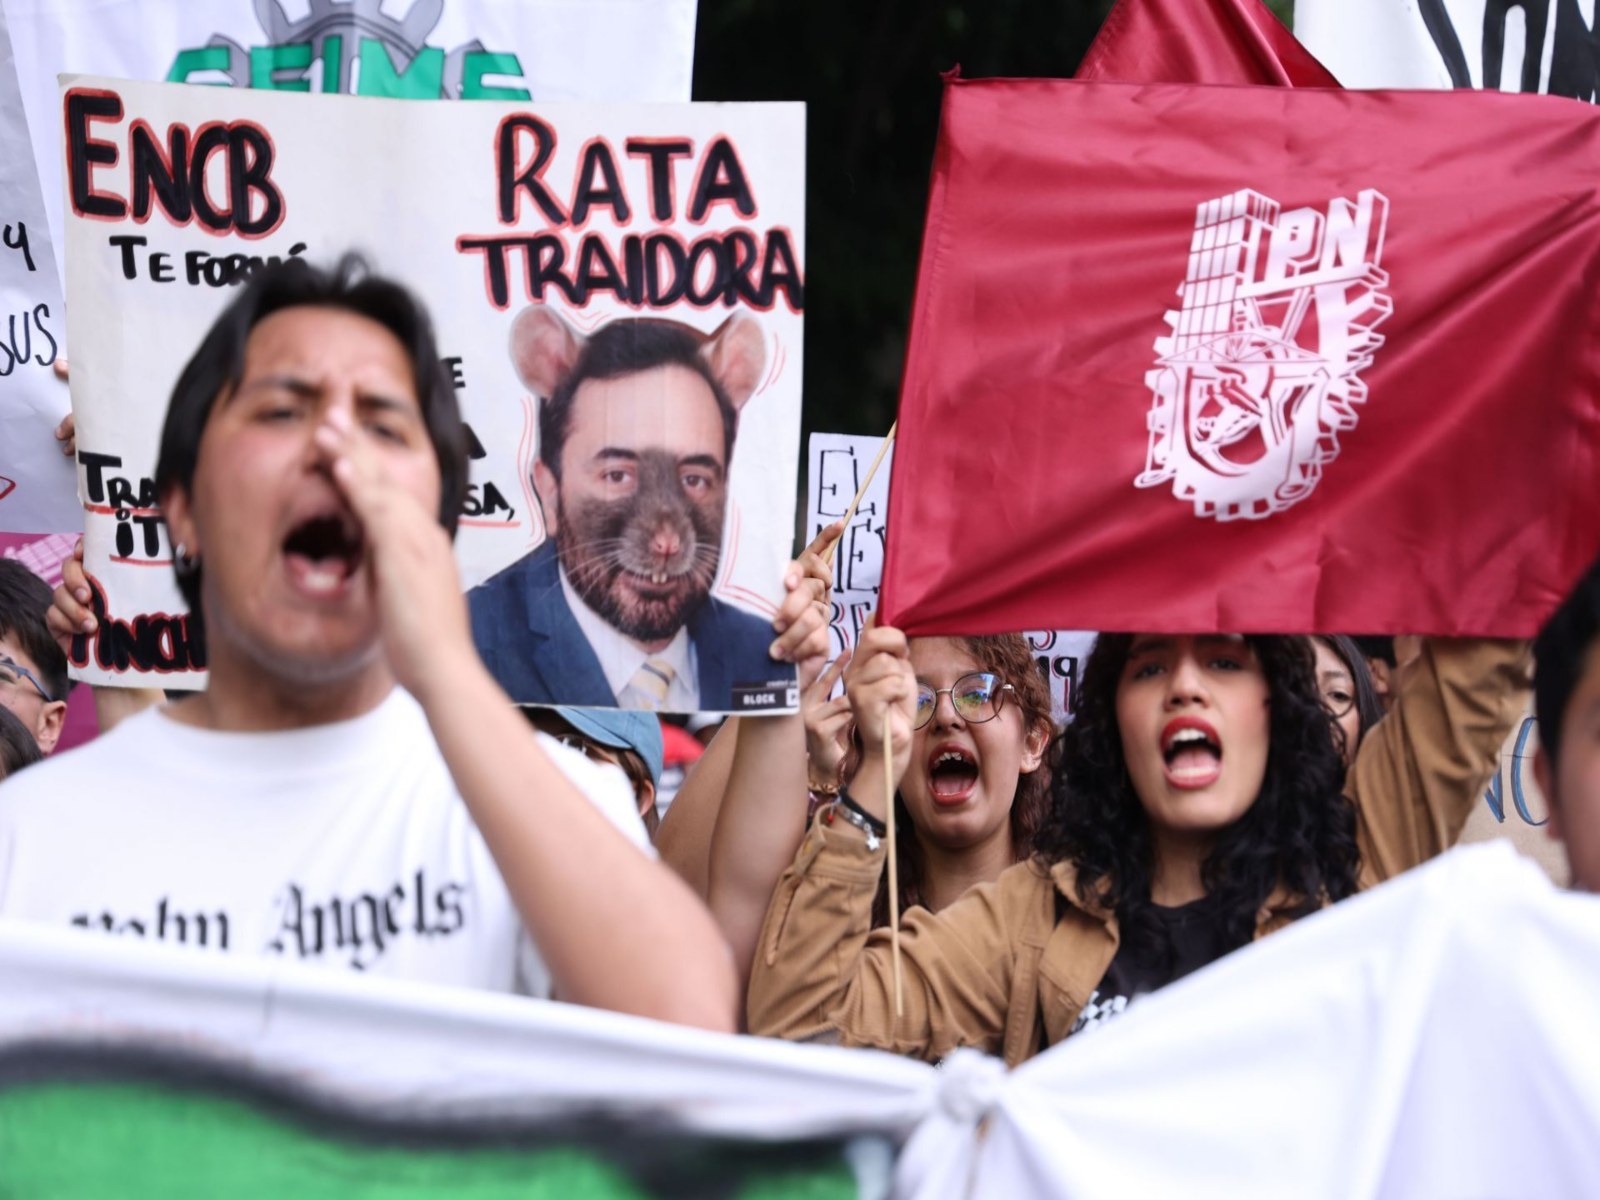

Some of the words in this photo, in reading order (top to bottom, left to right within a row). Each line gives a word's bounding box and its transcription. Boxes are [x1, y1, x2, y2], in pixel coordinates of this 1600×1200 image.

[64, 88, 286, 239] ENCB
[494, 112, 758, 231] RATA
[455, 226, 804, 314] TRAIDORA
[269, 868, 467, 971] Angels
